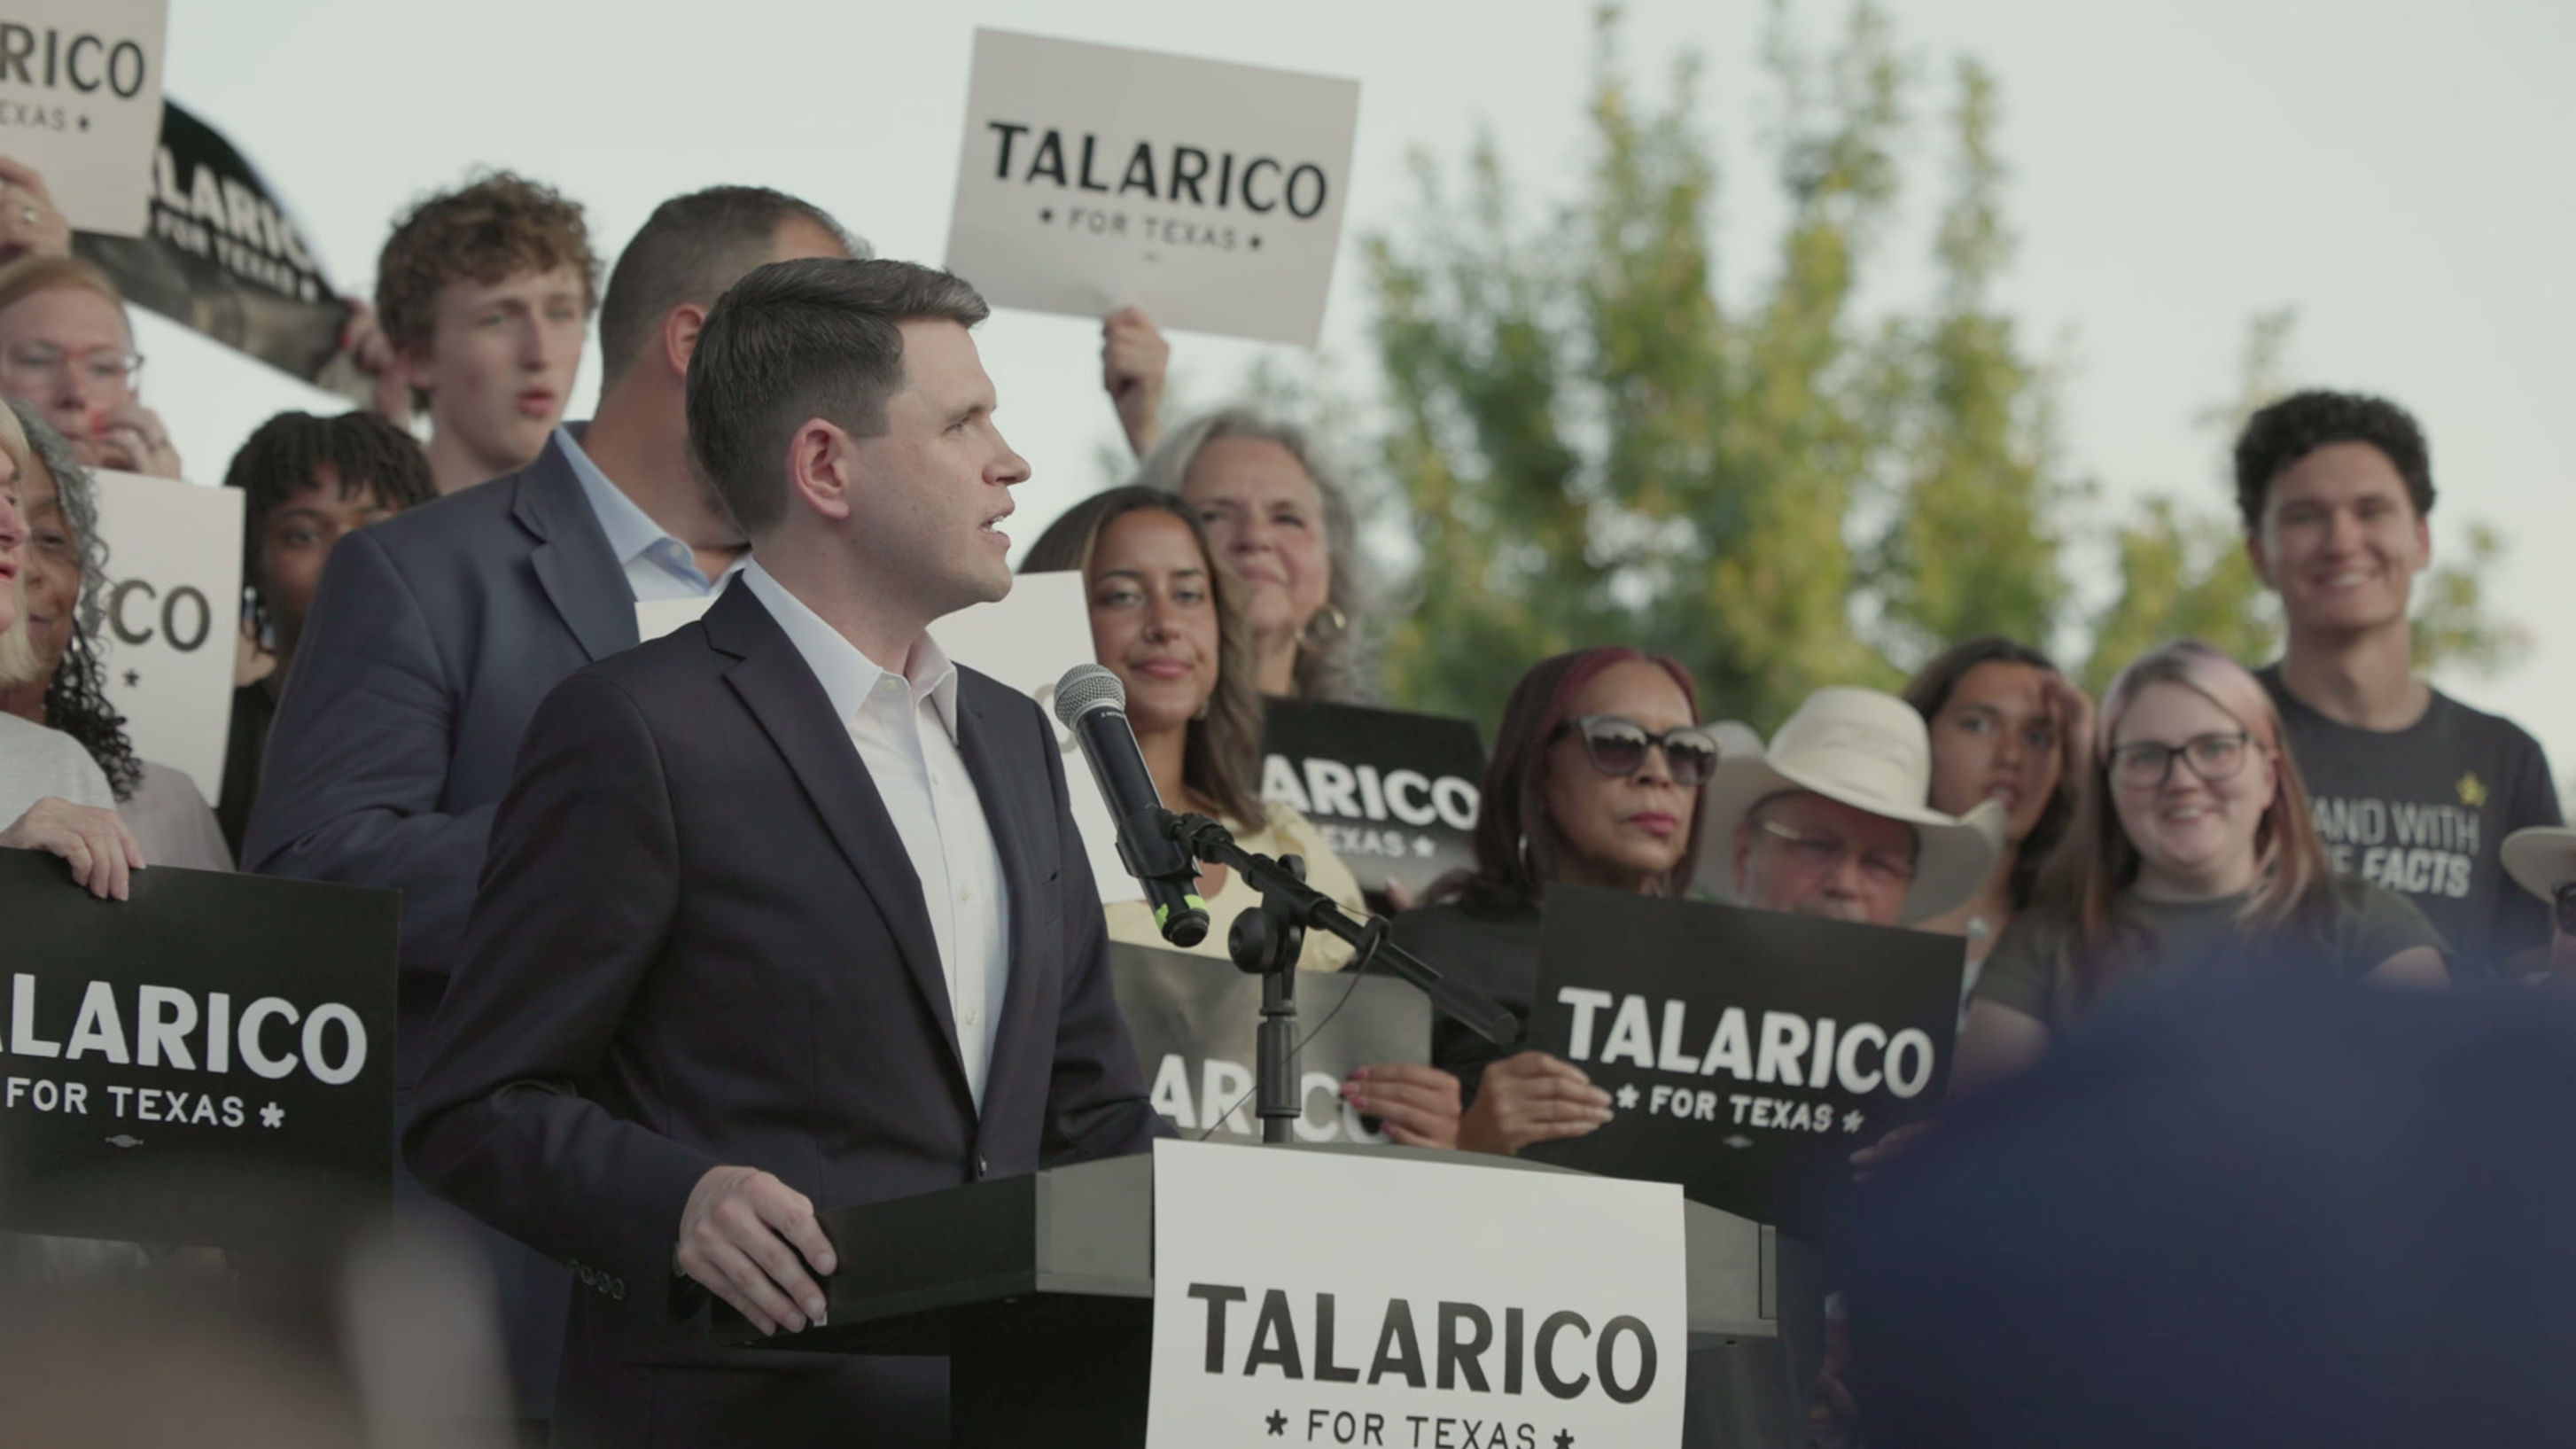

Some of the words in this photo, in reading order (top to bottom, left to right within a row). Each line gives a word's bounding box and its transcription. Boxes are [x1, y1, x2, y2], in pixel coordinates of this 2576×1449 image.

[0, 21, 144, 99] RICO
[988, 120, 1327, 221] TALARICO
[1069, 206, 1128, 238] FOR
[1143, 215, 1237, 251] TEXAS
[2392, 801, 2481, 856] WITH
[2362, 845, 2472, 899] FACTS
[0, 973, 368, 1085] LARICO
[1558, 985, 1934, 1099] TALARICO
[6, 1076, 88, 1115] FOR
[106, 1086, 245, 1127] TEXAS
[1649, 1085, 1718, 1122] FOR
[1729, 1094, 1834, 1133] TEXAS
[1187, 1282, 1658, 1404] TALARICO
[1307, 1408, 1385, 1447] FOR
[1405, 1415, 1536, 1449] TEXAS
